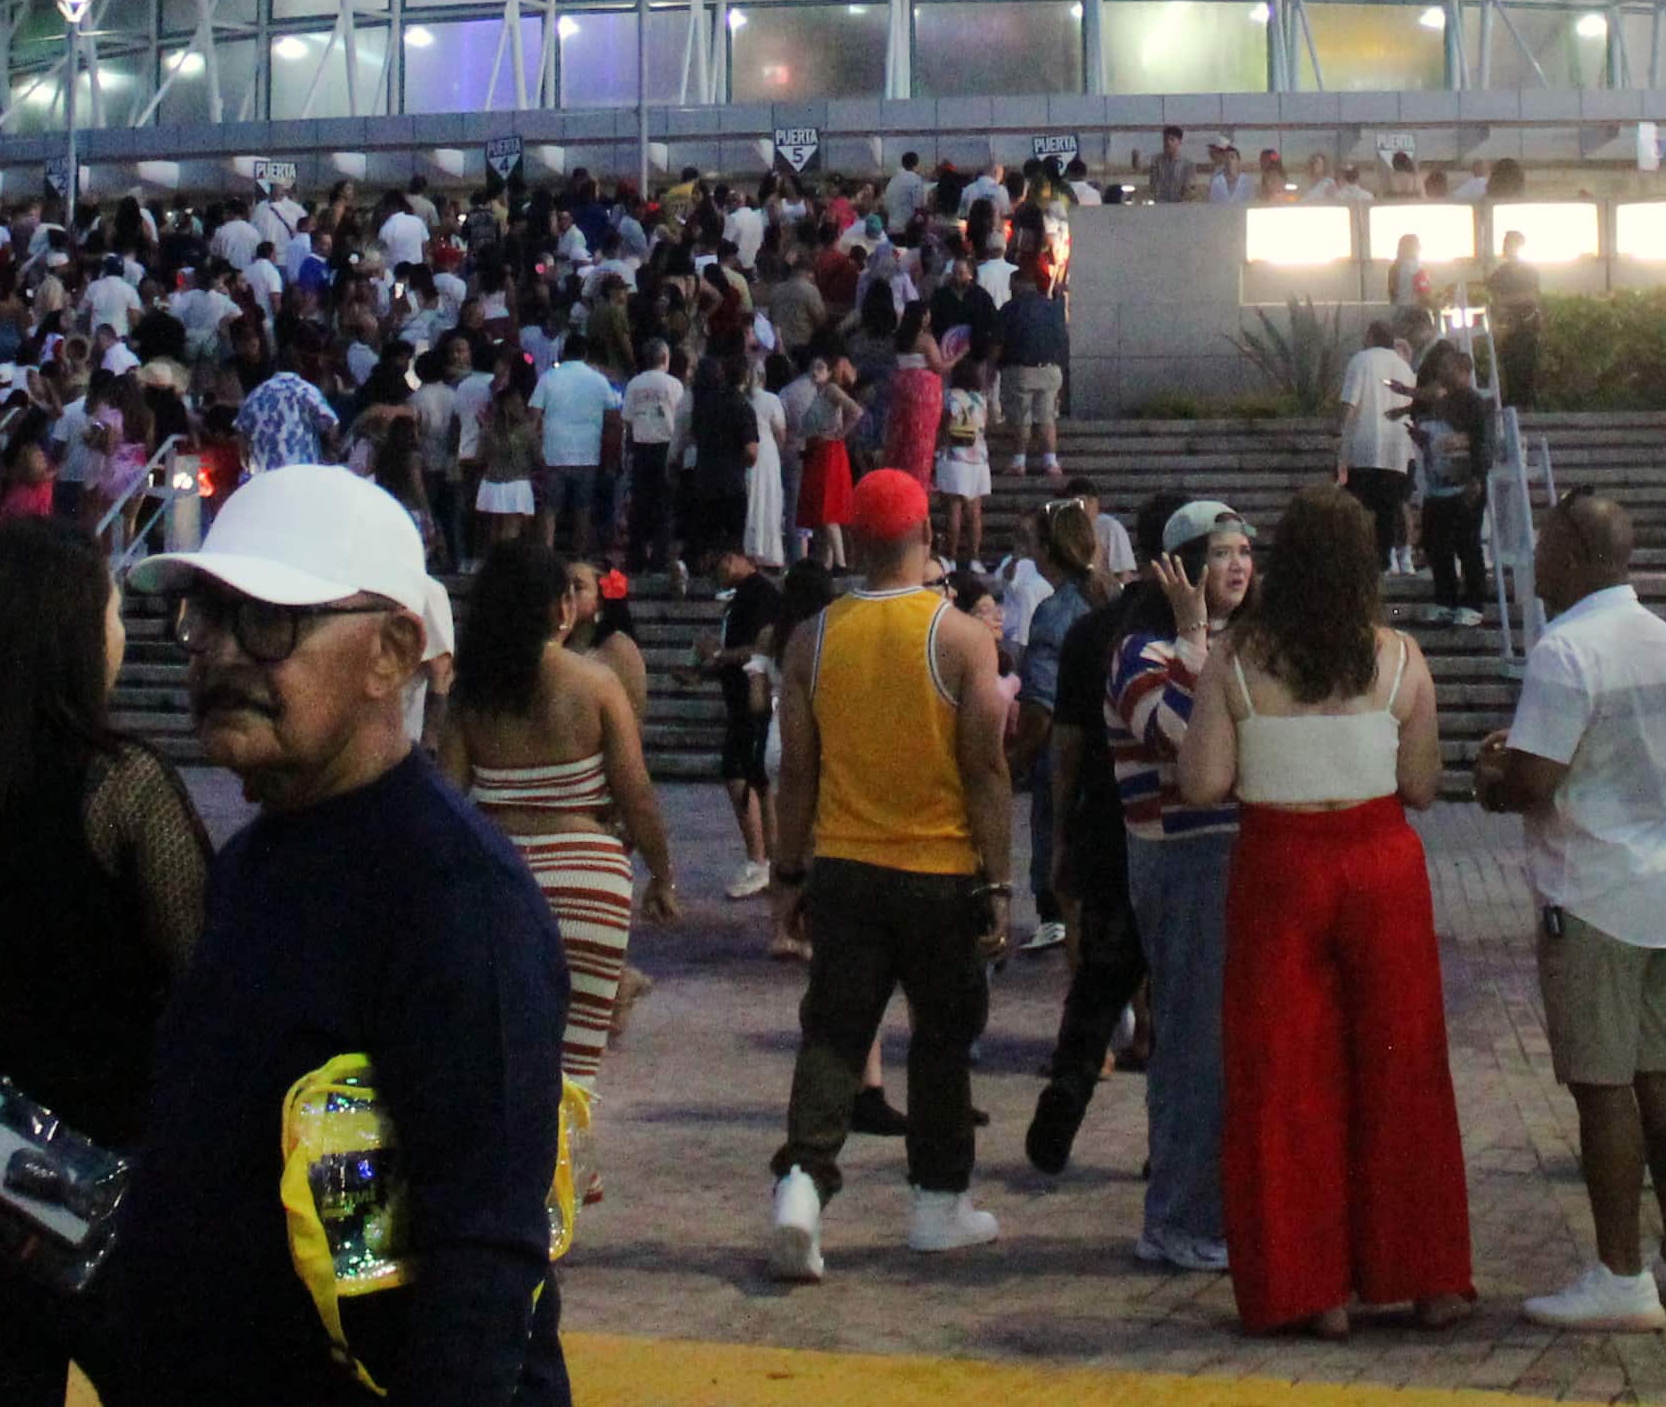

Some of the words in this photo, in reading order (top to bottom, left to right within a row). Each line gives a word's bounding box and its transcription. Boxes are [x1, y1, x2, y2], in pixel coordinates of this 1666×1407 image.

[775, 129, 819, 145] PUERTA
[1034, 135, 1078, 153] PUERTA
[792, 147, 804, 163] 5
[255, 162, 296, 179] PUERTA
